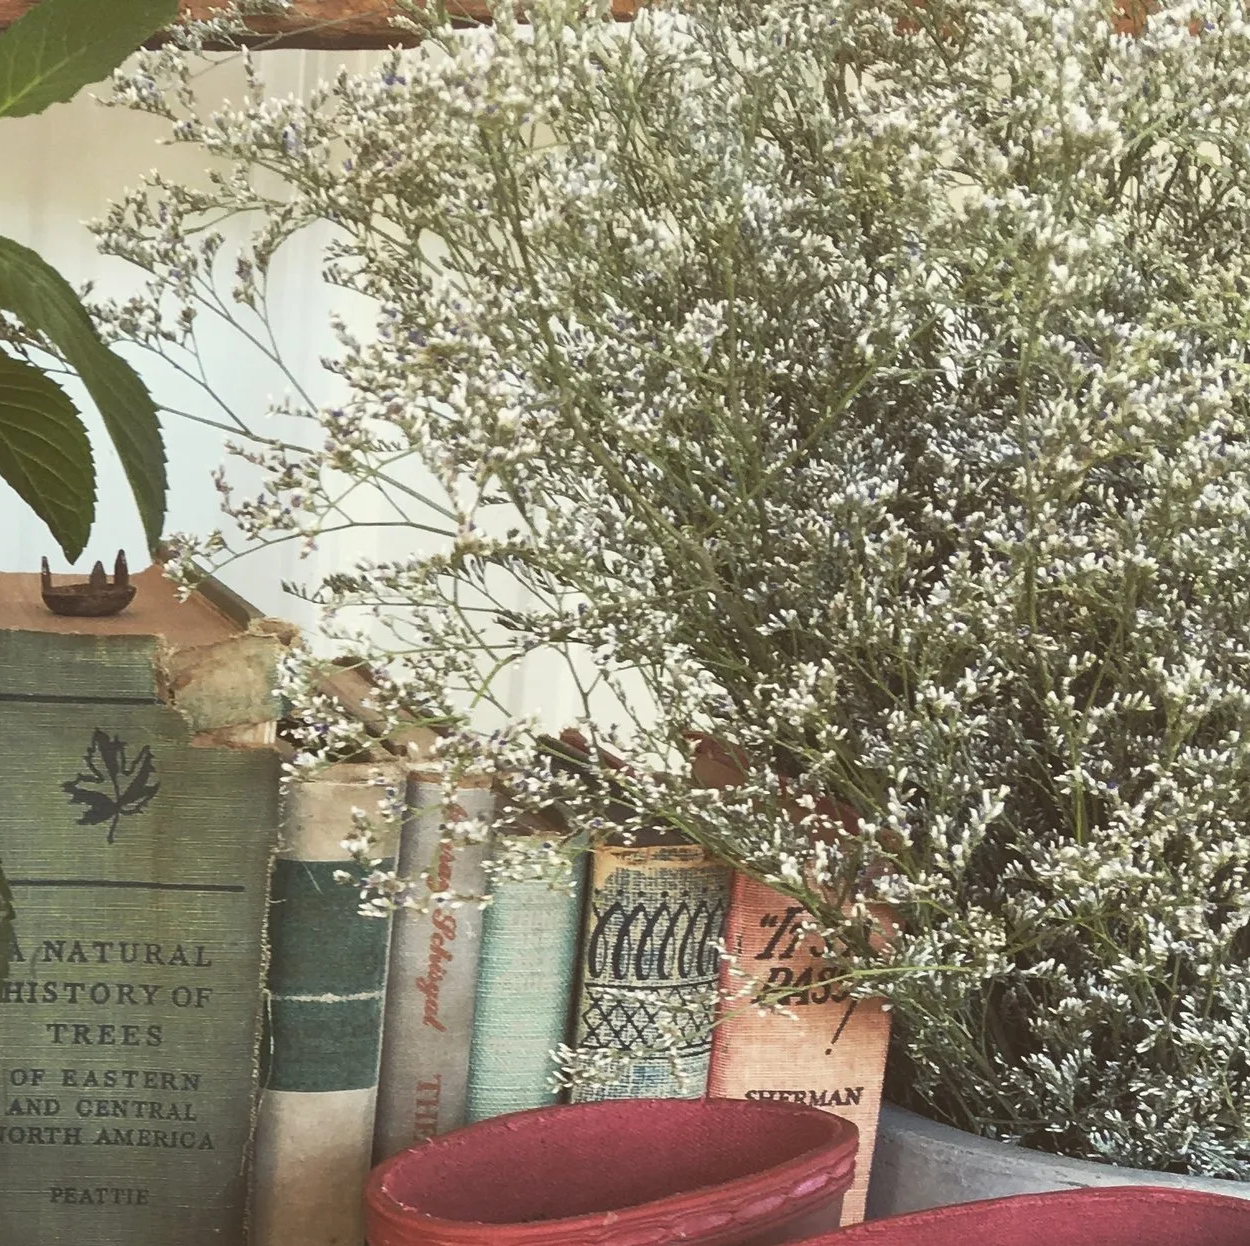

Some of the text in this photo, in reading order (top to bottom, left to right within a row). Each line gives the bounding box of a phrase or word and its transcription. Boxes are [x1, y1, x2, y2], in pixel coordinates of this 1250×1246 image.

[10, 940, 212, 967] A NATURAL
[415, 908, 457, 1032] Schisgal
[1, 981, 213, 1008] HISTORY OF
[46, 1023, 163, 1046] TREES
[10, 1068, 201, 1092] OF EASTERN
[744, 1087, 864, 1107] SHERMAN
[4, 1098, 197, 1121] AND CENTRAL
[92, 1128, 214, 1150] AMERICA
[50, 1187, 150, 1205] PEATTIE
